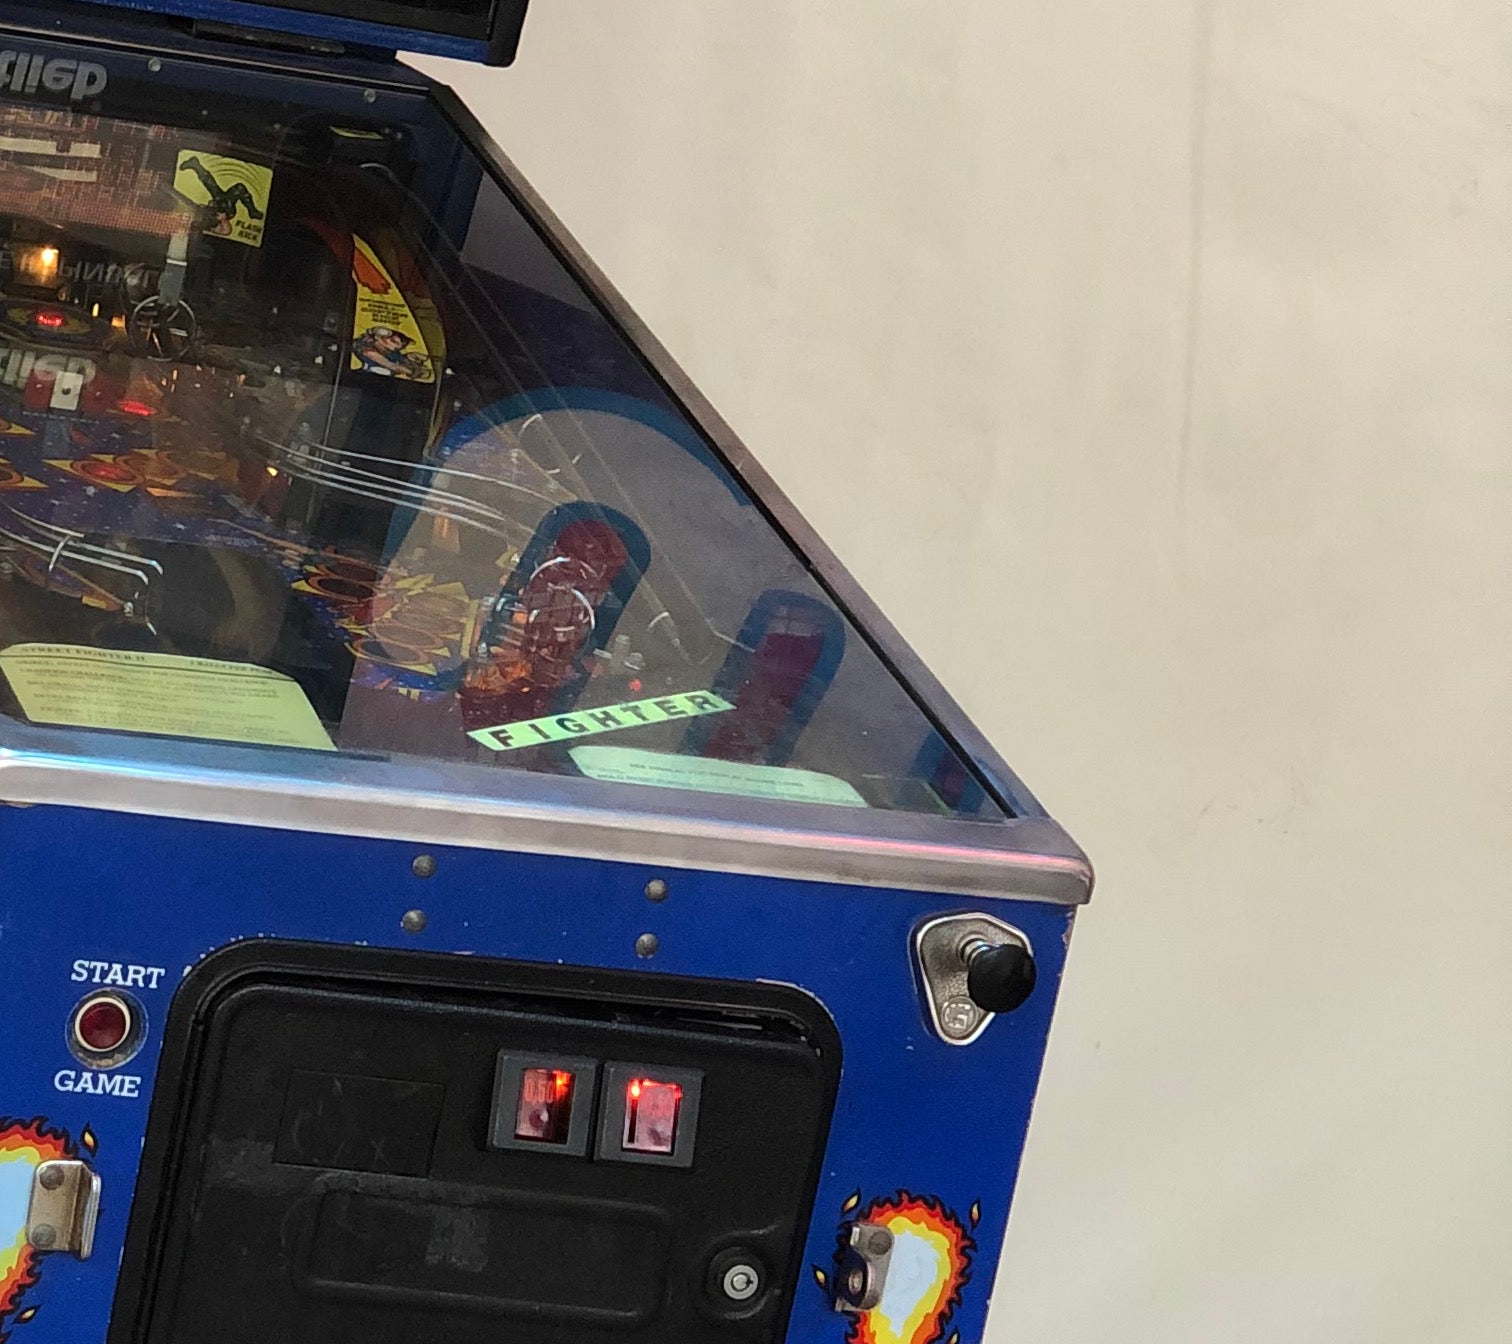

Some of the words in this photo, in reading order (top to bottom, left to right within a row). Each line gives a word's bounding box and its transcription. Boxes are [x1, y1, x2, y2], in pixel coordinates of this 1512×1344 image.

[488, 693, 725, 749] FIGHTER
[70, 959, 166, 989] START
[53, 1069, 142, 1098] GAME
